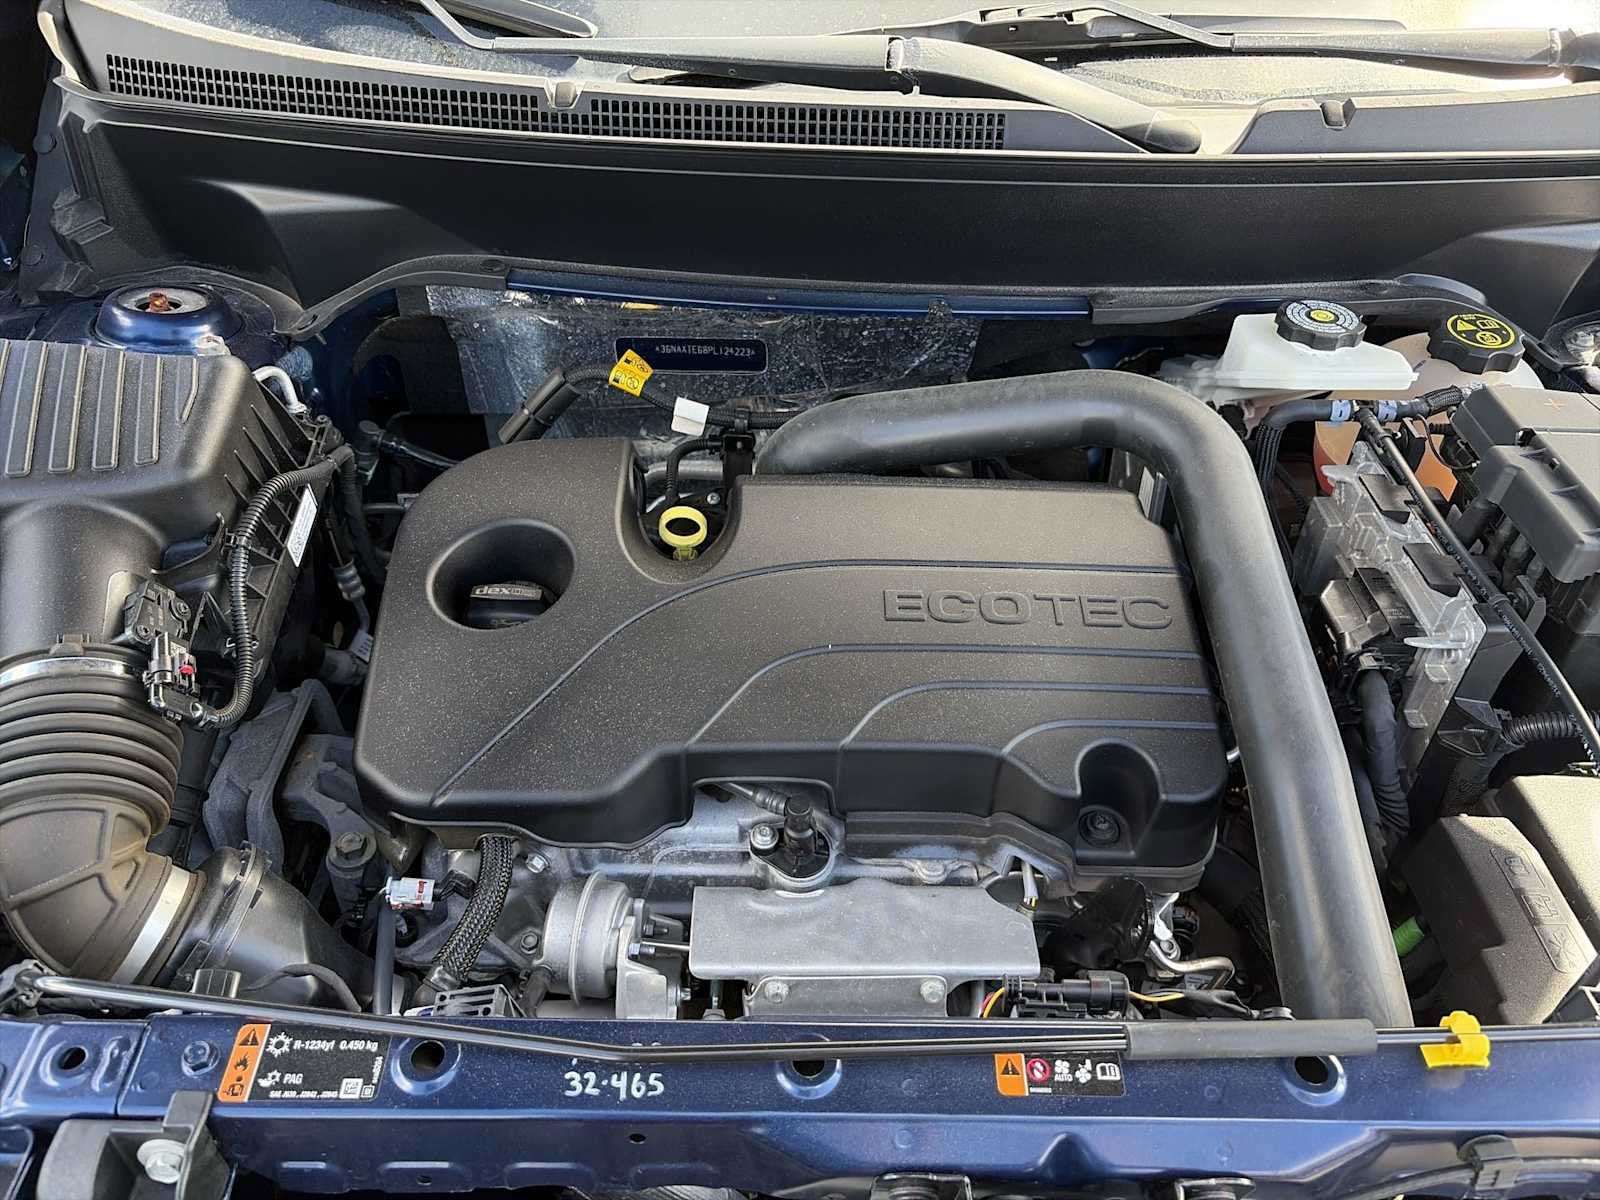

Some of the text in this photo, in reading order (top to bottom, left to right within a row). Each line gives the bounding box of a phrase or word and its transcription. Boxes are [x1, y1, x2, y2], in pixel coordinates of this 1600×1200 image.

[883, 589, 1172, 629] ECOTEC
[293, 1040, 379, 1051] R-1234yf 0.450 kg
[283, 1073, 303, 1084] PAG
[1054, 1073, 1073, 1082] AUTO
